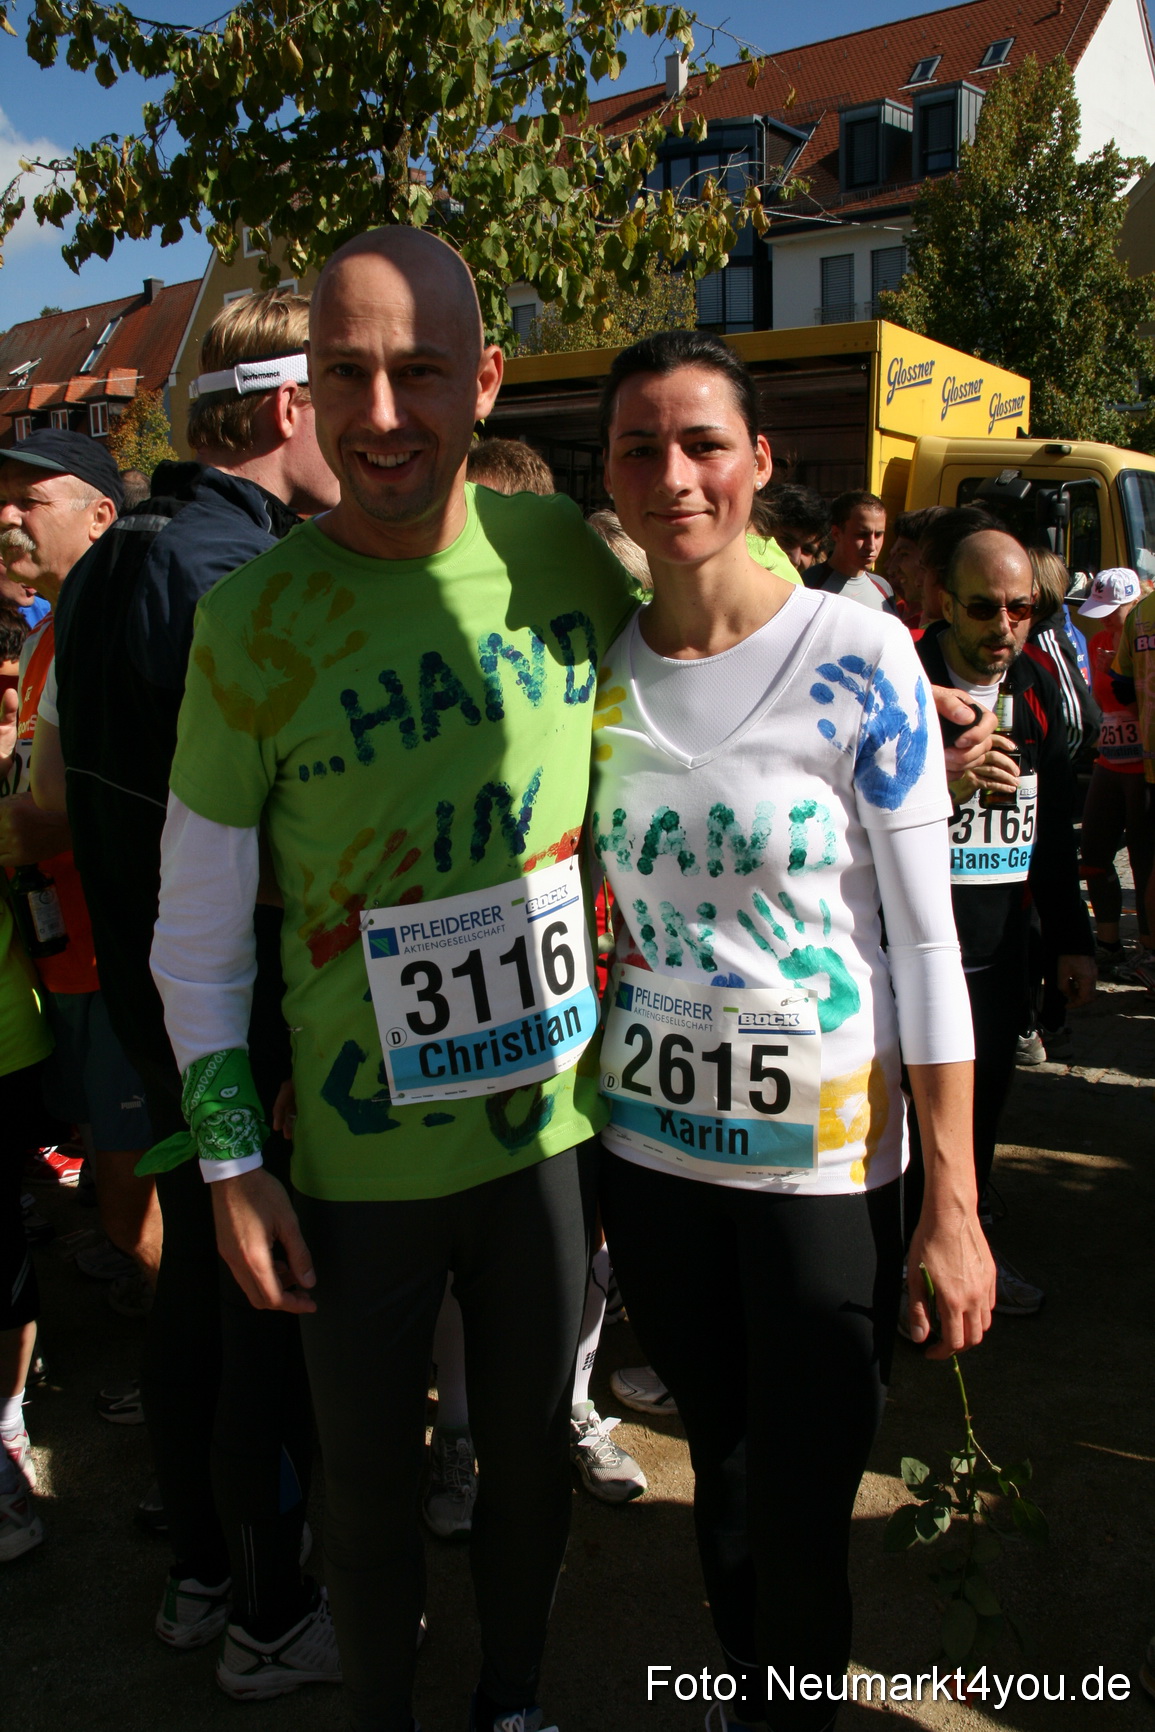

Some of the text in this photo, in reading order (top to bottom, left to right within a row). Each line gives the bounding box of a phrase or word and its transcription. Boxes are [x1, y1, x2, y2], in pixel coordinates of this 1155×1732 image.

[886, 357, 935, 406] Glossner
[941, 376, 983, 421] Glossner
[988, 393, 1025, 435] Glossner
[1101, 723, 1139, 746] 2513
[434, 765, 543, 873] IN
[592, 800, 838, 878] HAND
[952, 804, 1035, 845] 3165
[526, 885, 568, 914] BOCK
[400, 905, 504, 943] PFLEIDERER
[403, 924, 506, 955] AKTIENGESELLSCHAFT
[633, 898, 717, 973] IN
[401, 920, 575, 1036] 3116
[633, 1008, 713, 1033] AKTIENGESELLSCHAFT
[634, 987, 713, 1021] PFLEIDERER
[738, 1013, 800, 1027] BOCK
[418, 1006, 582, 1079] Christian
[621, 1023, 791, 1115] 2615
[654, 1106, 749, 1156] Karin
